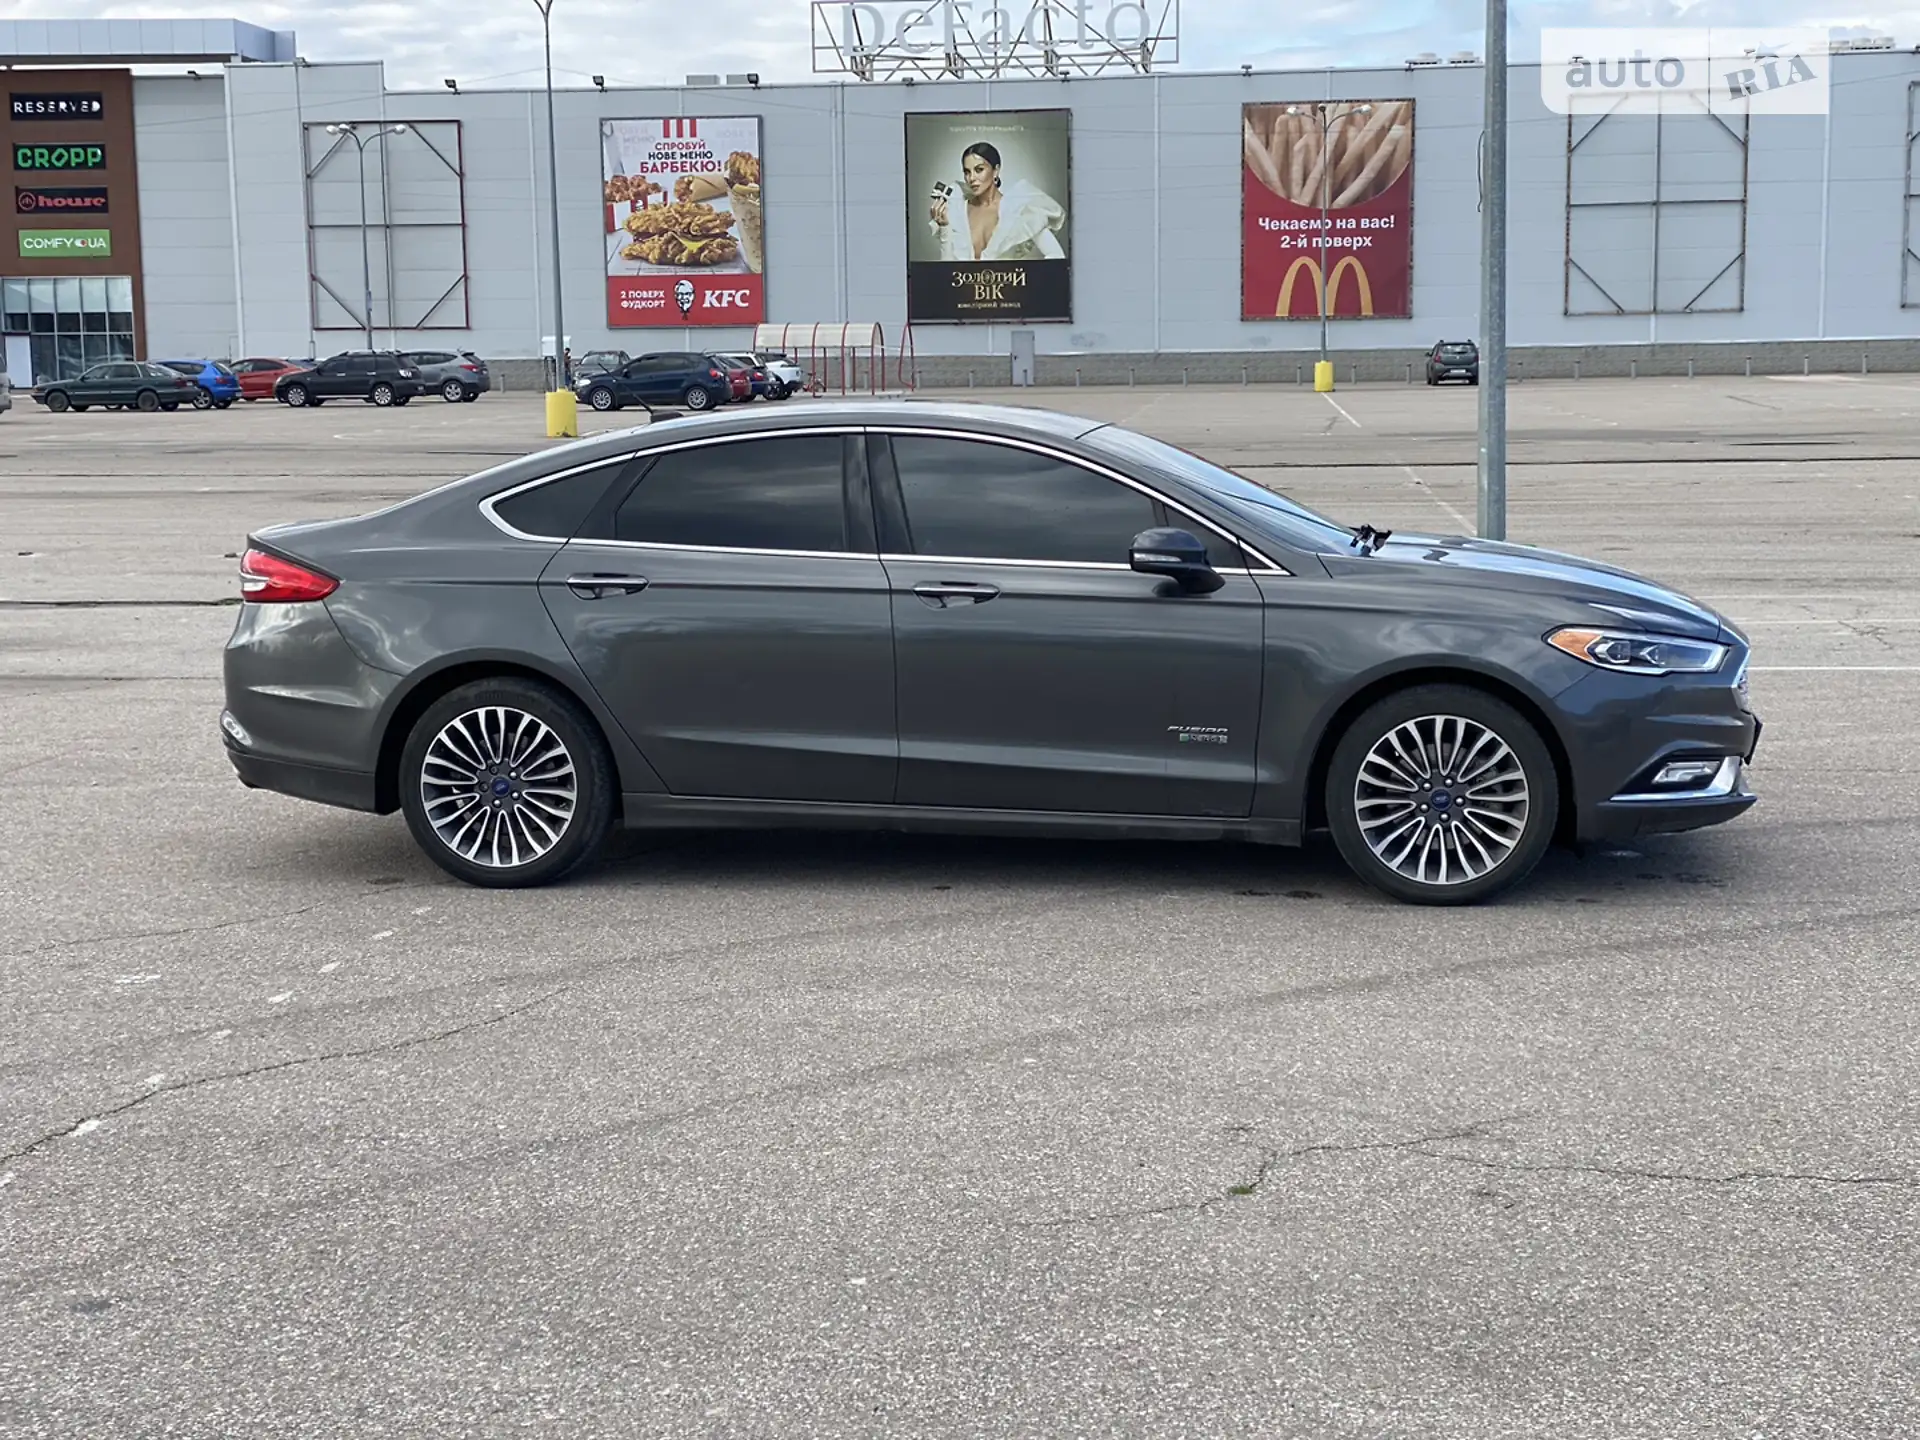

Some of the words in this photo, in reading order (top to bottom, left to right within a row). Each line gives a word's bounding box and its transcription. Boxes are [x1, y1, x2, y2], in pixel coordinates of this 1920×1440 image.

[13, 101, 101, 113] RESERVED
[654, 139, 706, 151] СПРОБУЙ
[16, 147, 102, 168] CROPP
[648, 151, 677, 161] НОВЕ
[680, 150, 713, 160] МЕНЮ
[640, 160, 722, 174] БАРБЕКЮ!
[37, 195, 106, 207] house
[1258, 217, 1332, 231] Чекаємо
[1336, 217, 1356, 229] на
[1360, 215, 1395, 229] вас!
[23, 238, 74, 249] COMFY
[1280, 234, 1308, 249] 2-й
[1312, 235, 1373, 251] поверх
[620, 290, 626, 299] 2
[628, 290, 665, 299] ПОВЕРХ
[702, 290, 750, 308] KFC
[620, 300, 666, 310] ФУДКОРТ
